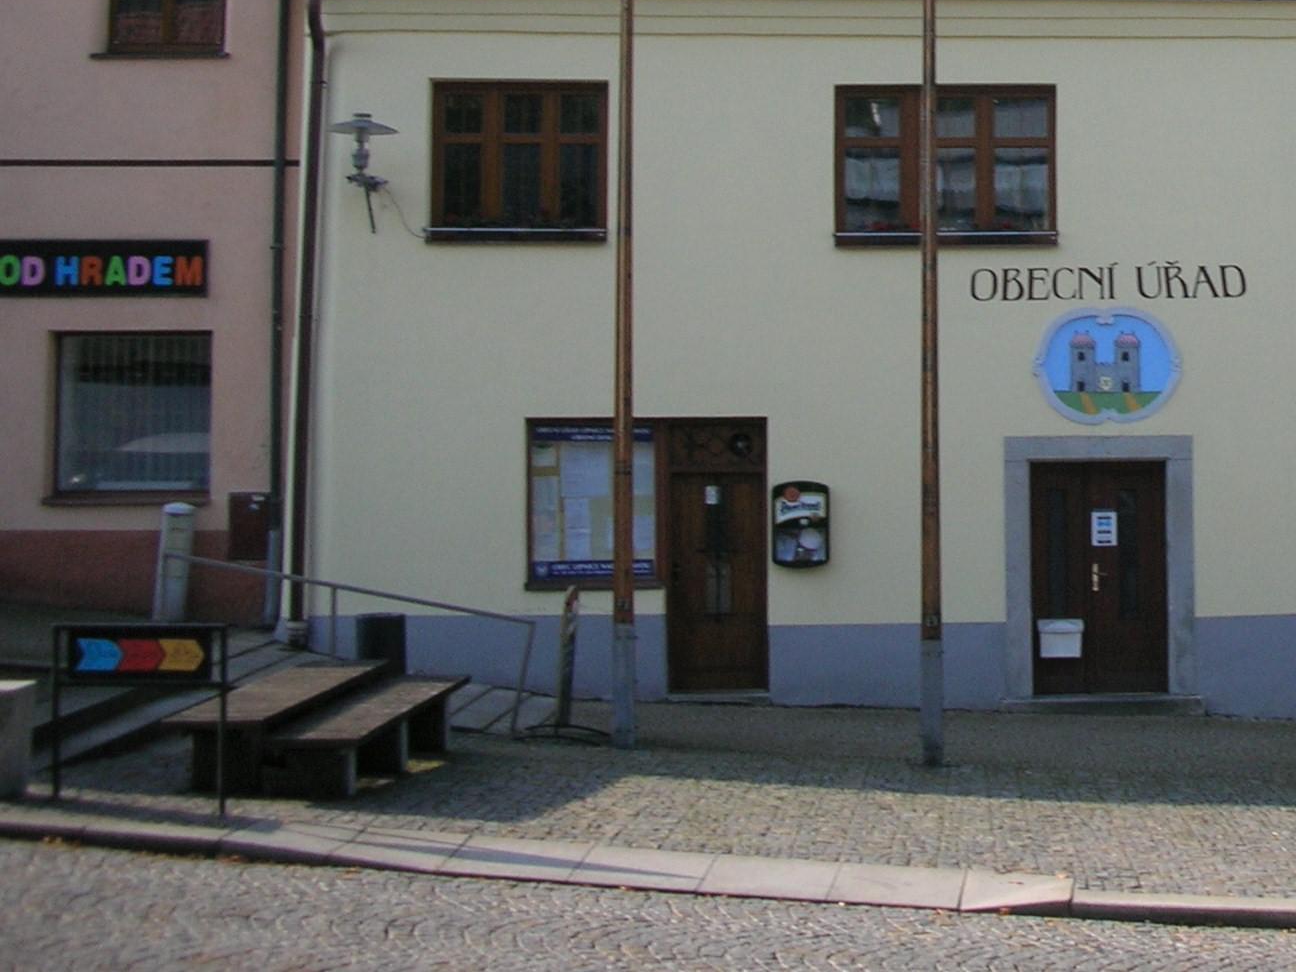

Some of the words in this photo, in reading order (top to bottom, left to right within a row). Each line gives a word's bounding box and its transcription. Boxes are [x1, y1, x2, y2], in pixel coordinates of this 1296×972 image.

[55, 255, 203, 286] HRADEM
[970, 262, 1119, 302] OBECNÍ
[1136, 260, 1247, 299] ÚŘAD
